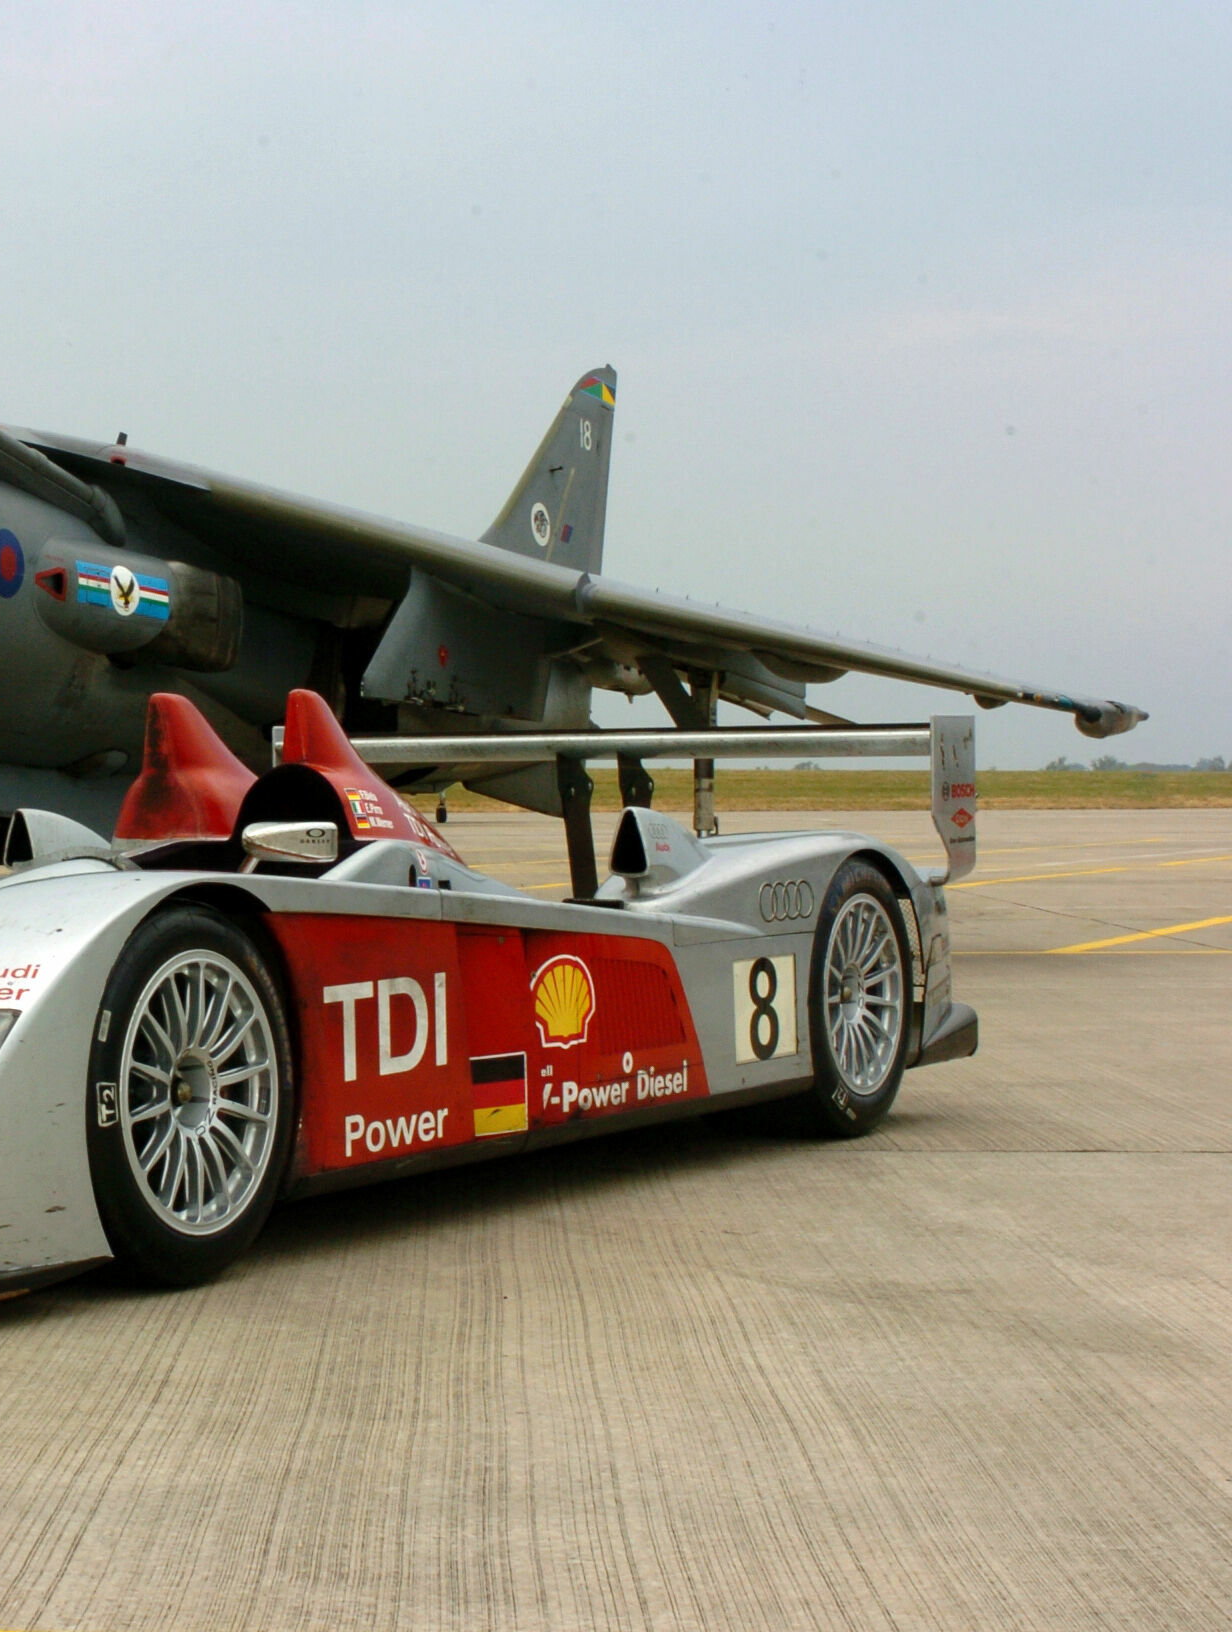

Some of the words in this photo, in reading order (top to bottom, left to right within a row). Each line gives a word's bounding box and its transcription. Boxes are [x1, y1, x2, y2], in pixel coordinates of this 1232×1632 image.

[580, 418, 592, 449] 18
[951, 783, 976, 798] BOSCH
[323, 972, 448, 1083] TDI
[749, 957, 779, 1061] 8
[636, 1059, 688, 1101] Diesel
[100, 1086, 116, 1123] T2
[344, 1107, 449, 1158] Power
